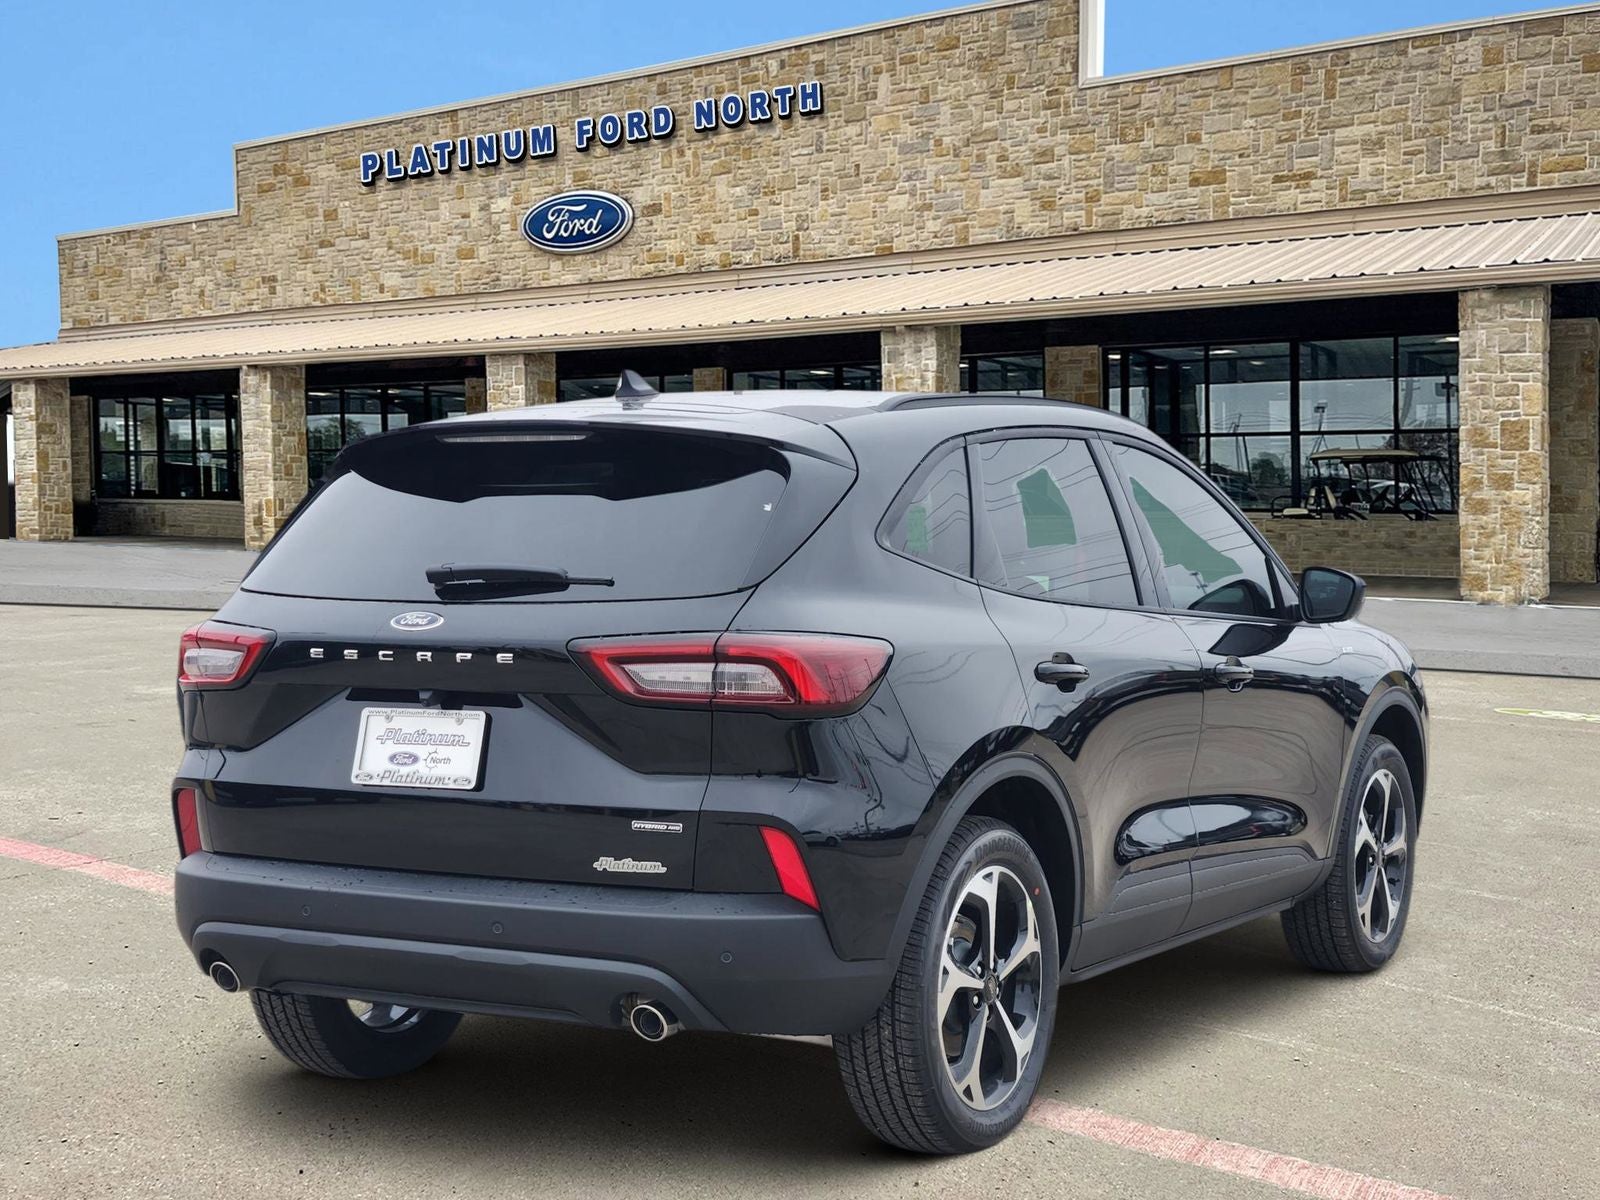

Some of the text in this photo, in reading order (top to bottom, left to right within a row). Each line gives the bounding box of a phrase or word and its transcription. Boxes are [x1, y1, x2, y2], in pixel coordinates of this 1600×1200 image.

[360, 80, 823, 186] PLATINUM FORD NORTH
[542, 204, 602, 239] Ford
[400, 613, 431, 625] Ford
[309, 648, 514, 663] ESCAPE
[367, 708, 481, 719] www.PlatinumFordNorth.com
[376, 727, 471, 747] Platinum
[393, 752, 452, 766] Ford North
[593, 856, 667, 873] Platinum
